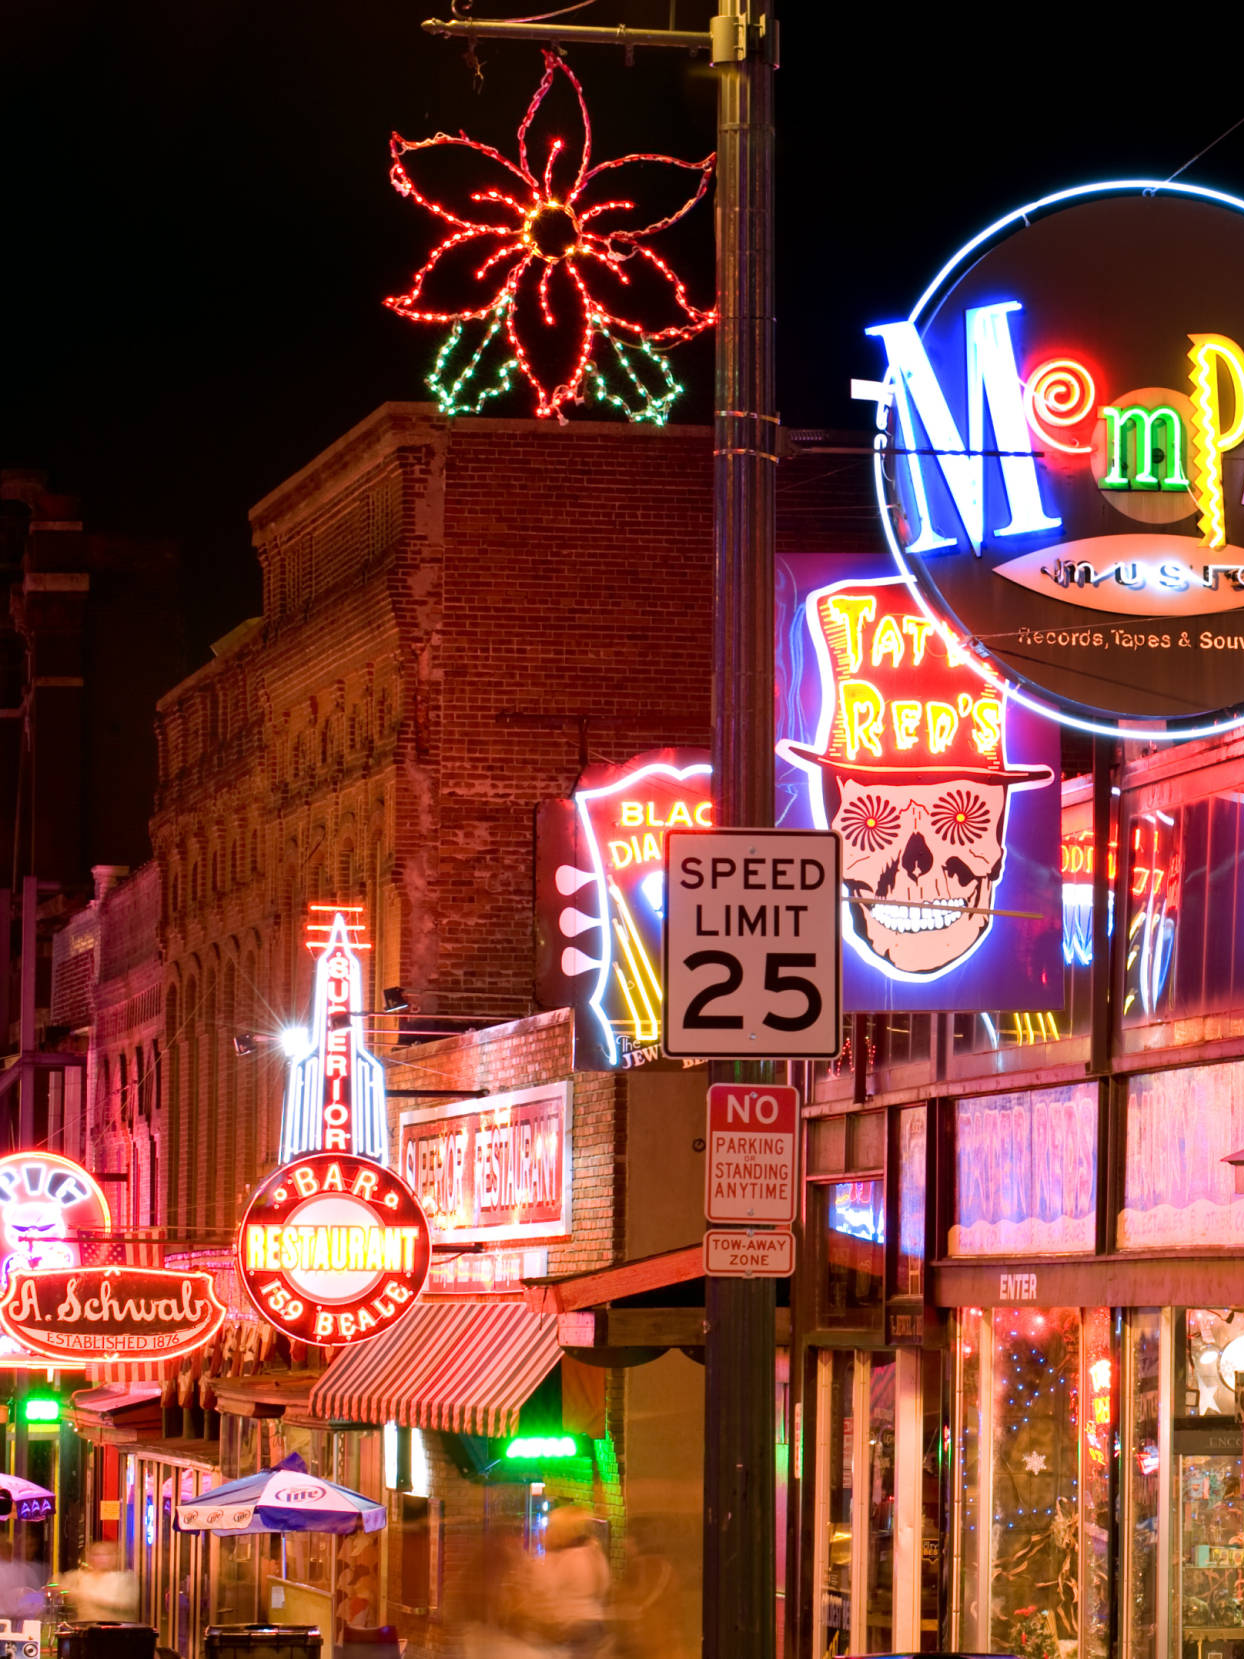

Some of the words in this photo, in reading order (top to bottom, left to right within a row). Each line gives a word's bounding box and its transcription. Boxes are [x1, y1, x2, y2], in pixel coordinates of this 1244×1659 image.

[828, 595, 970, 674] TAT
[1178, 632, 1191, 648] &
[839, 679, 1002, 761] RED'S
[620, 801, 712, 827] BLAC
[608, 832, 664, 870] DIA
[680, 857, 825, 891] SPEED
[696, 904, 808, 937] LIMIT
[682, 950, 823, 1032] 25
[324, 956, 350, 1150] SUERIOR
[616, 1035, 641, 1053] The
[621, 1043, 661, 1069] JEW
[727, 1094, 779, 1124] NO
[716, 1137, 784, 1155] PARKING
[474, 1116, 560, 1211] RESTAURANT
[715, 1163, 788, 1180] STANDING
[292, 1161, 379, 1201] BAR
[715, 1182, 788, 1200] ANYTIME
[247, 1224, 419, 1273] RESTAURANT
[713, 1239, 786, 1251] TOW-AWAY
[729, 1255, 769, 1266] ZONE
[8, 1279, 52, 1321] A.
[58, 1278, 212, 1322] Schwab
[1000, 1274, 1037, 1300] ENTER
[260, 1279, 304, 1321] 159
[314, 1281, 412, 1336] BEALE
[47, 1334, 147, 1349] ESTABLISHED
[153, 1334, 179, 1348] 1876
